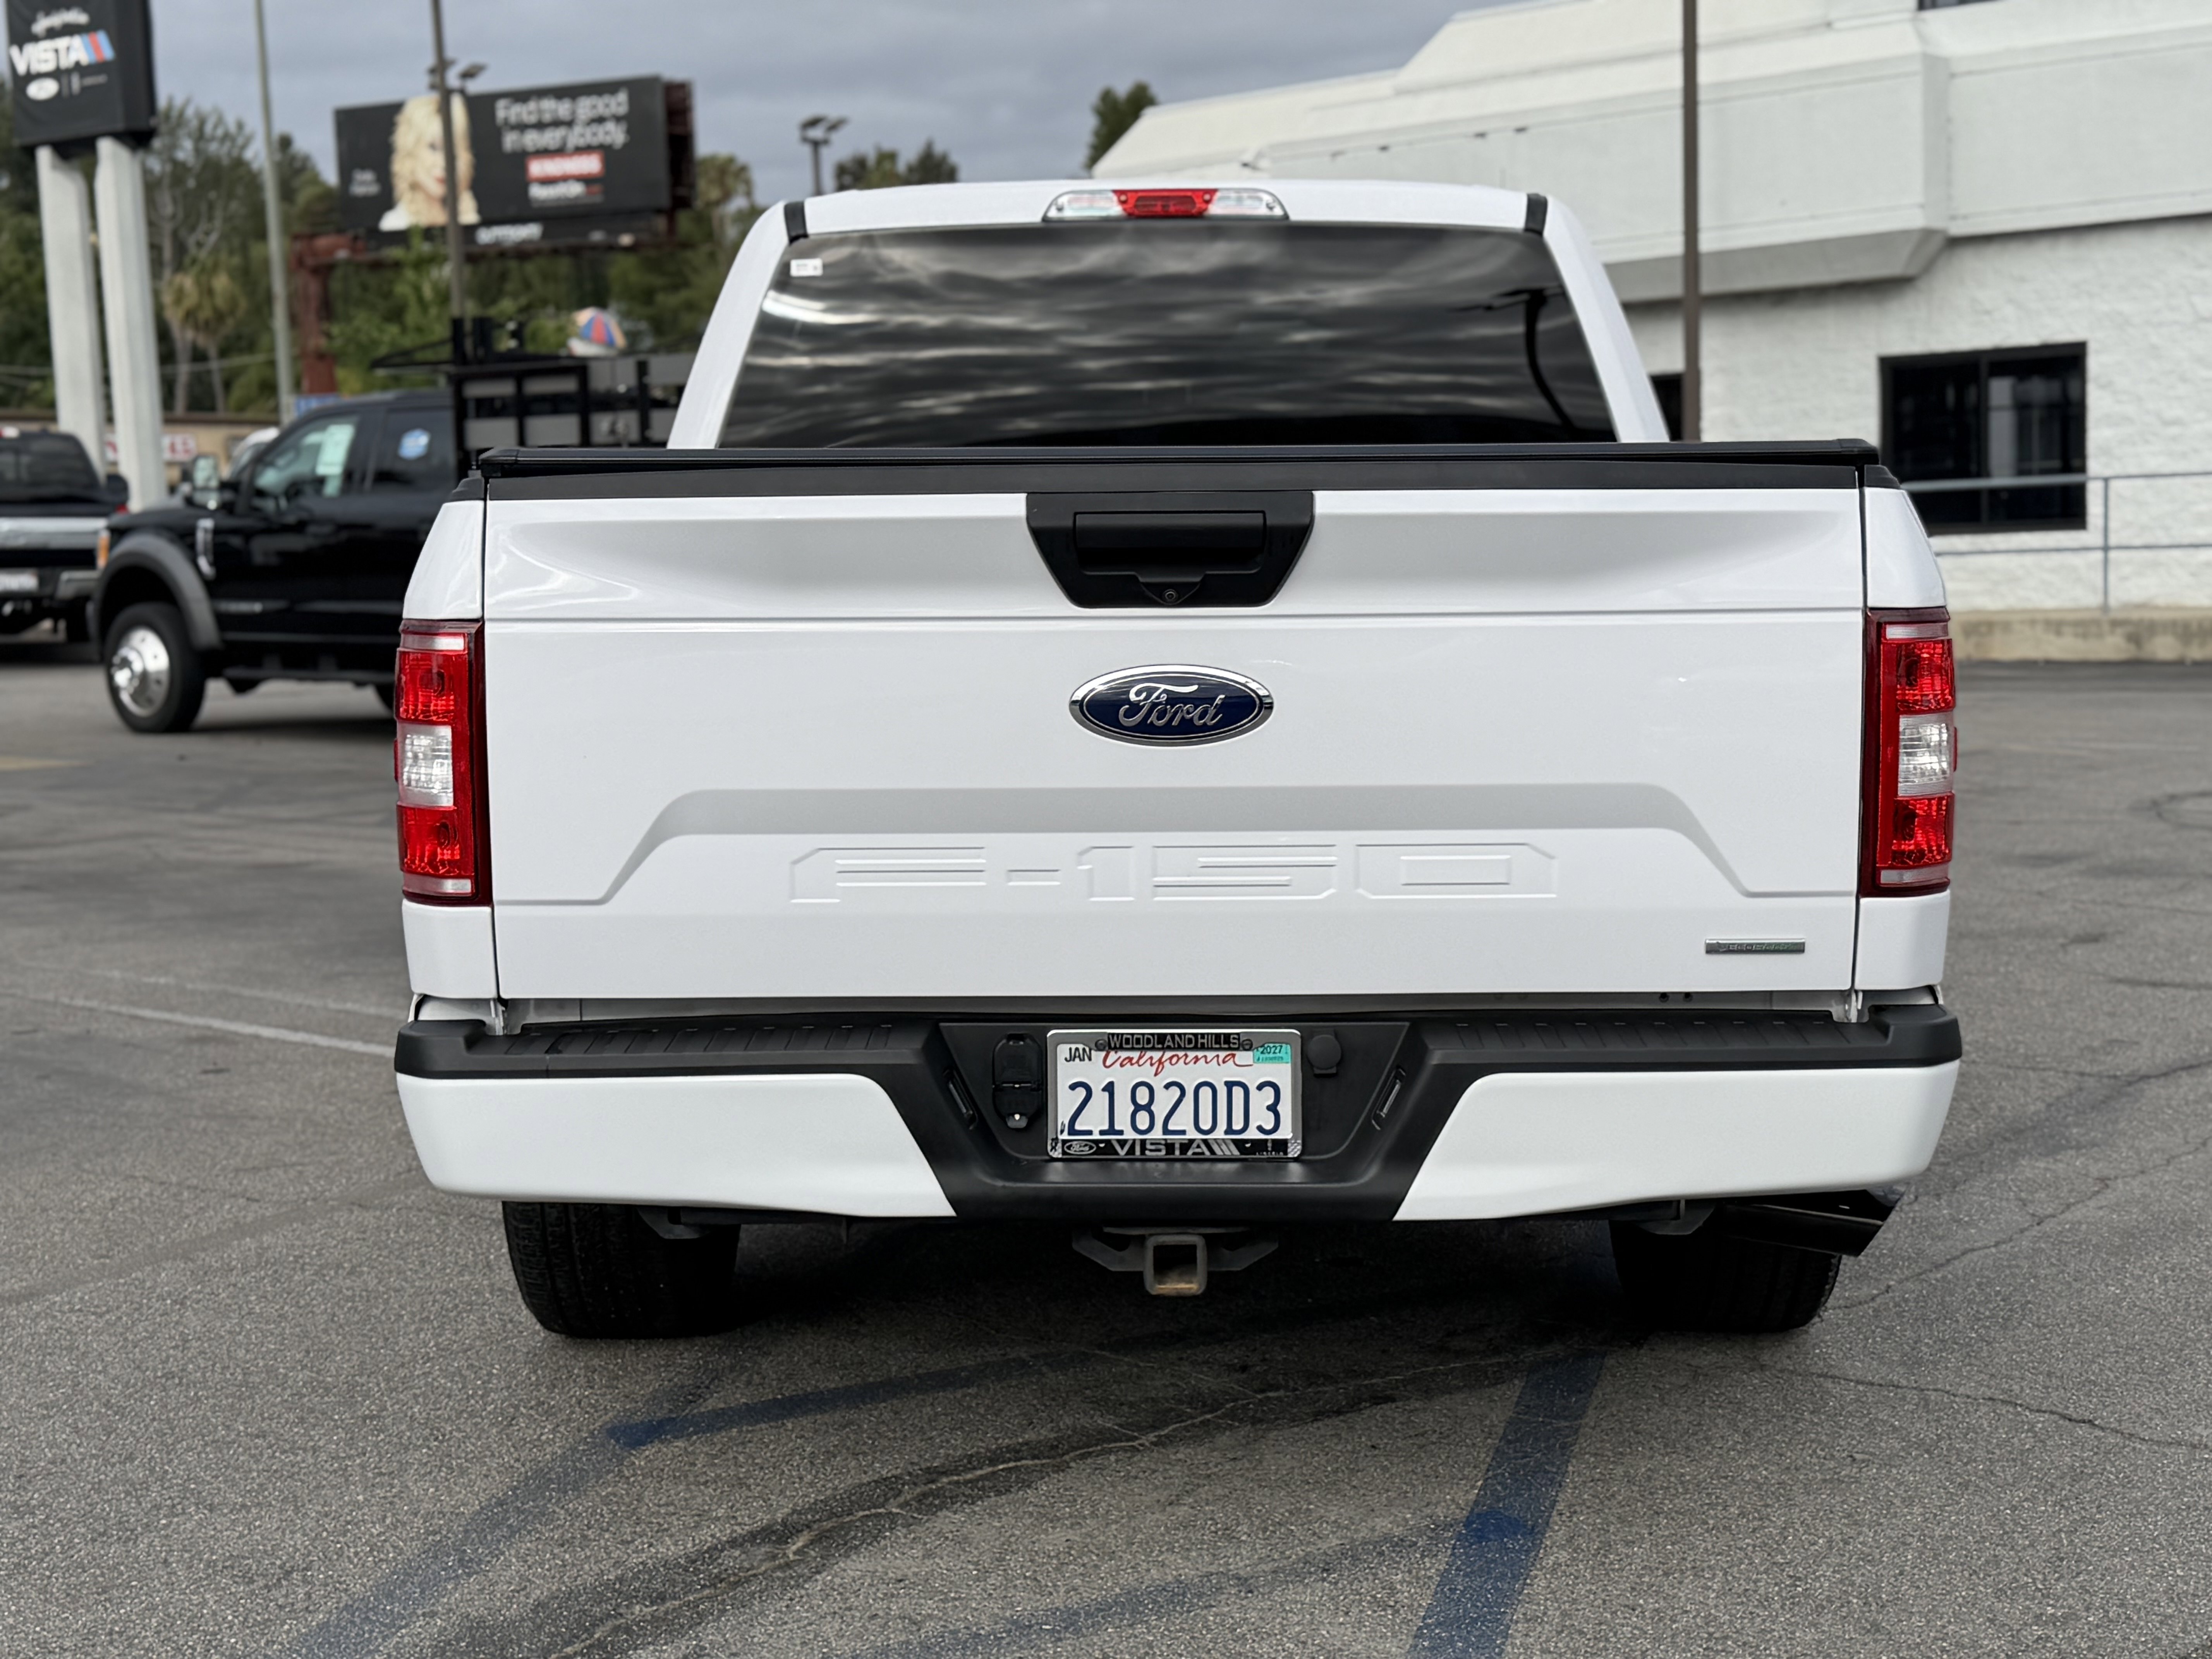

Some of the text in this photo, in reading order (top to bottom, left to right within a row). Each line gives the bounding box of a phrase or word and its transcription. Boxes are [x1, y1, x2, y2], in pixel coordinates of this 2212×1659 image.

[10, 34, 89, 76] VISTA
[1119, 683, 1225, 726] Ford
[790, 844, 1557, 902] F-150
[1065, 1047, 1092, 1063] JAN
[1109, 1034, 1239, 1049] WOODLAND HILLS
[1260, 1045, 1283, 1054] 2027
[1102, 1050, 1253, 1077] California
[1067, 1080, 1281, 1136] 21820D3
[1111, 1139, 1209, 1156] VISTA
